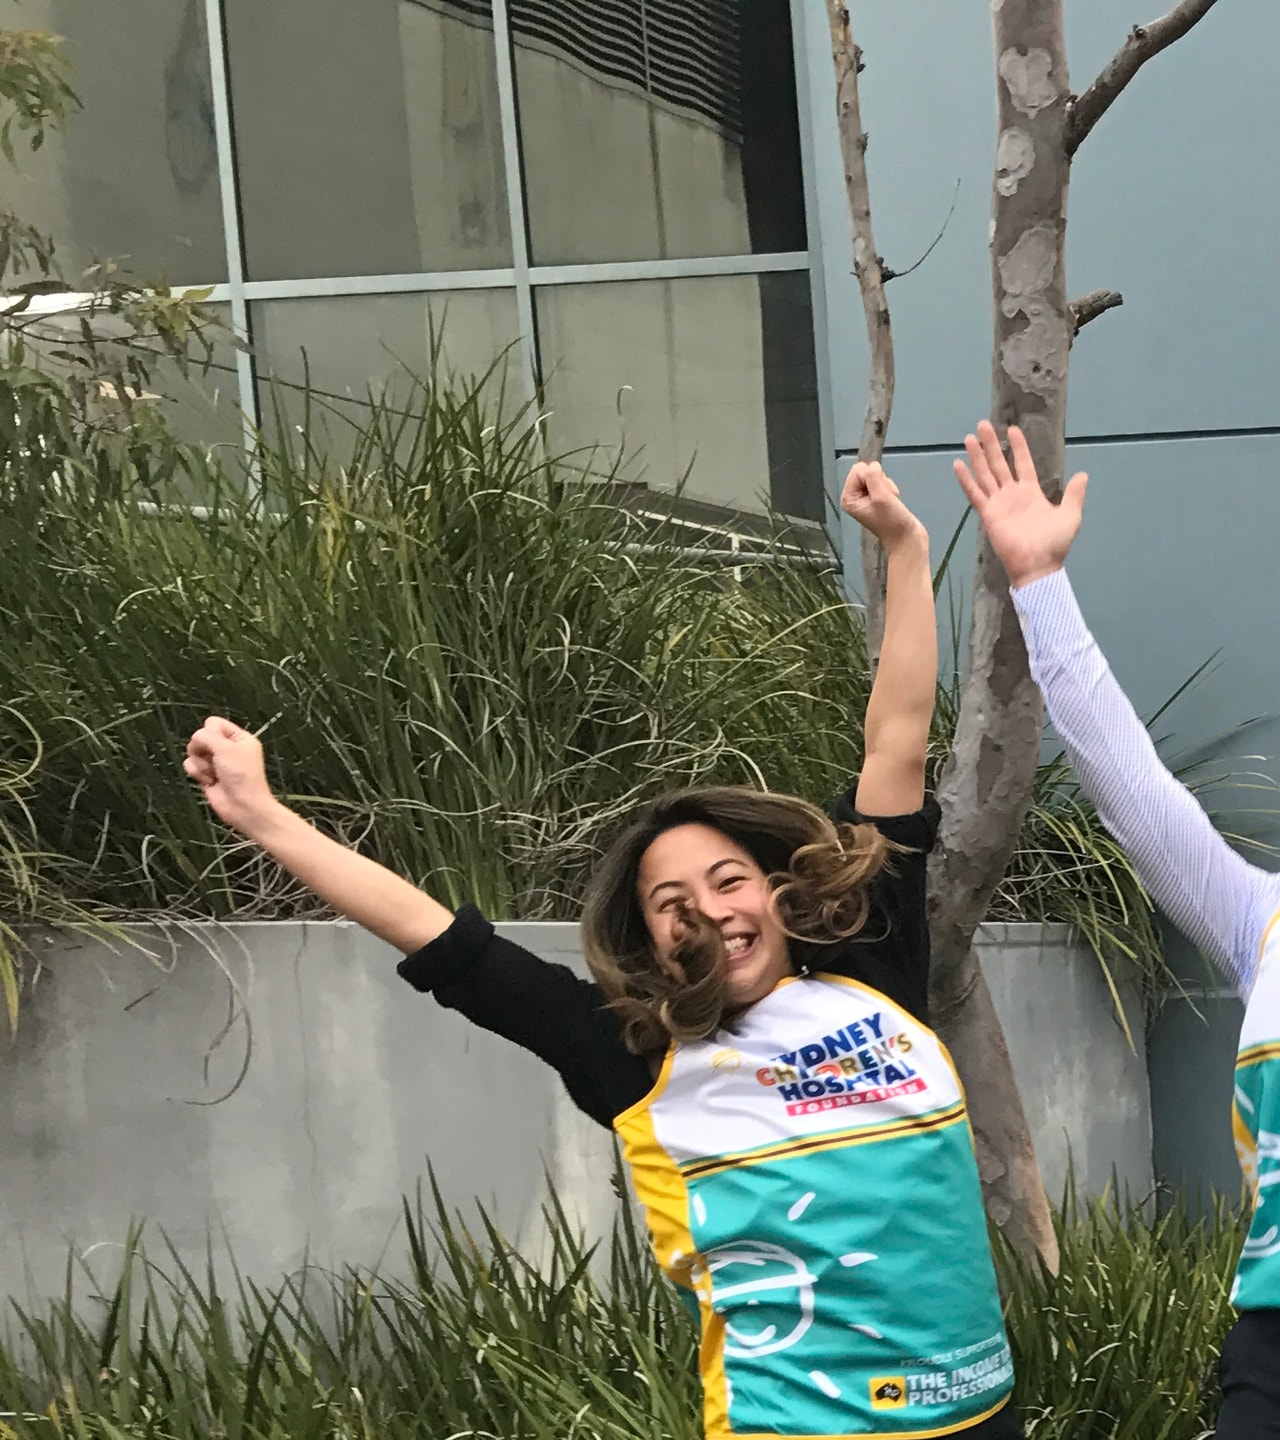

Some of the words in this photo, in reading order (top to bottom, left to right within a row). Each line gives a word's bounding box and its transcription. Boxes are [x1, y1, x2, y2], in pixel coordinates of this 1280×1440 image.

[770, 1012, 884, 1068] YDNEY
[794, 1082, 920, 1115] FOUNDATION
[906, 1372, 947, 1390] THE
